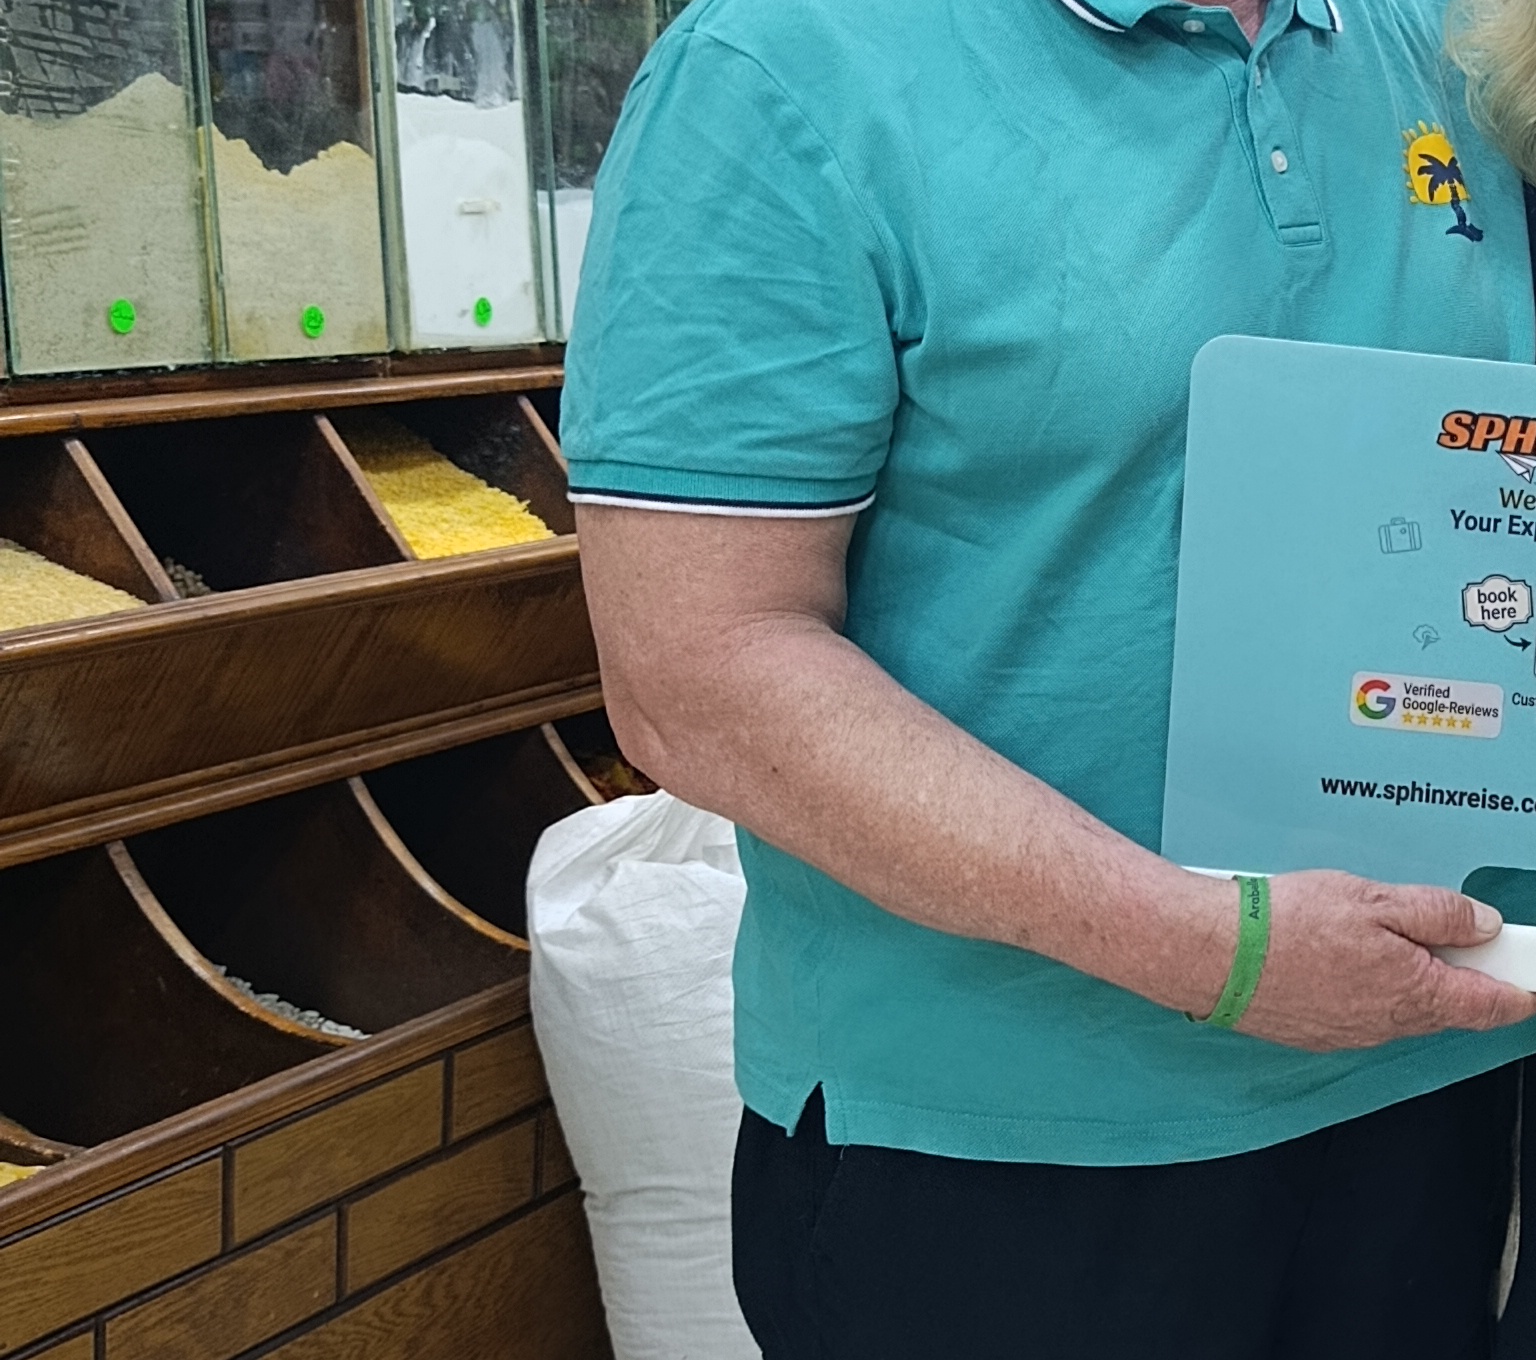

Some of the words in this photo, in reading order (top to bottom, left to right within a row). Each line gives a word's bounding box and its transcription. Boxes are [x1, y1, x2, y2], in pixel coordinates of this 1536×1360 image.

[1450, 509, 1502, 533] Your
[1477, 587, 1518, 604] book
[1480, 605, 1517, 621] here
[1403, 682, 1451, 699] Verified
[1402, 697, 1499, 718] Google-Reviews
